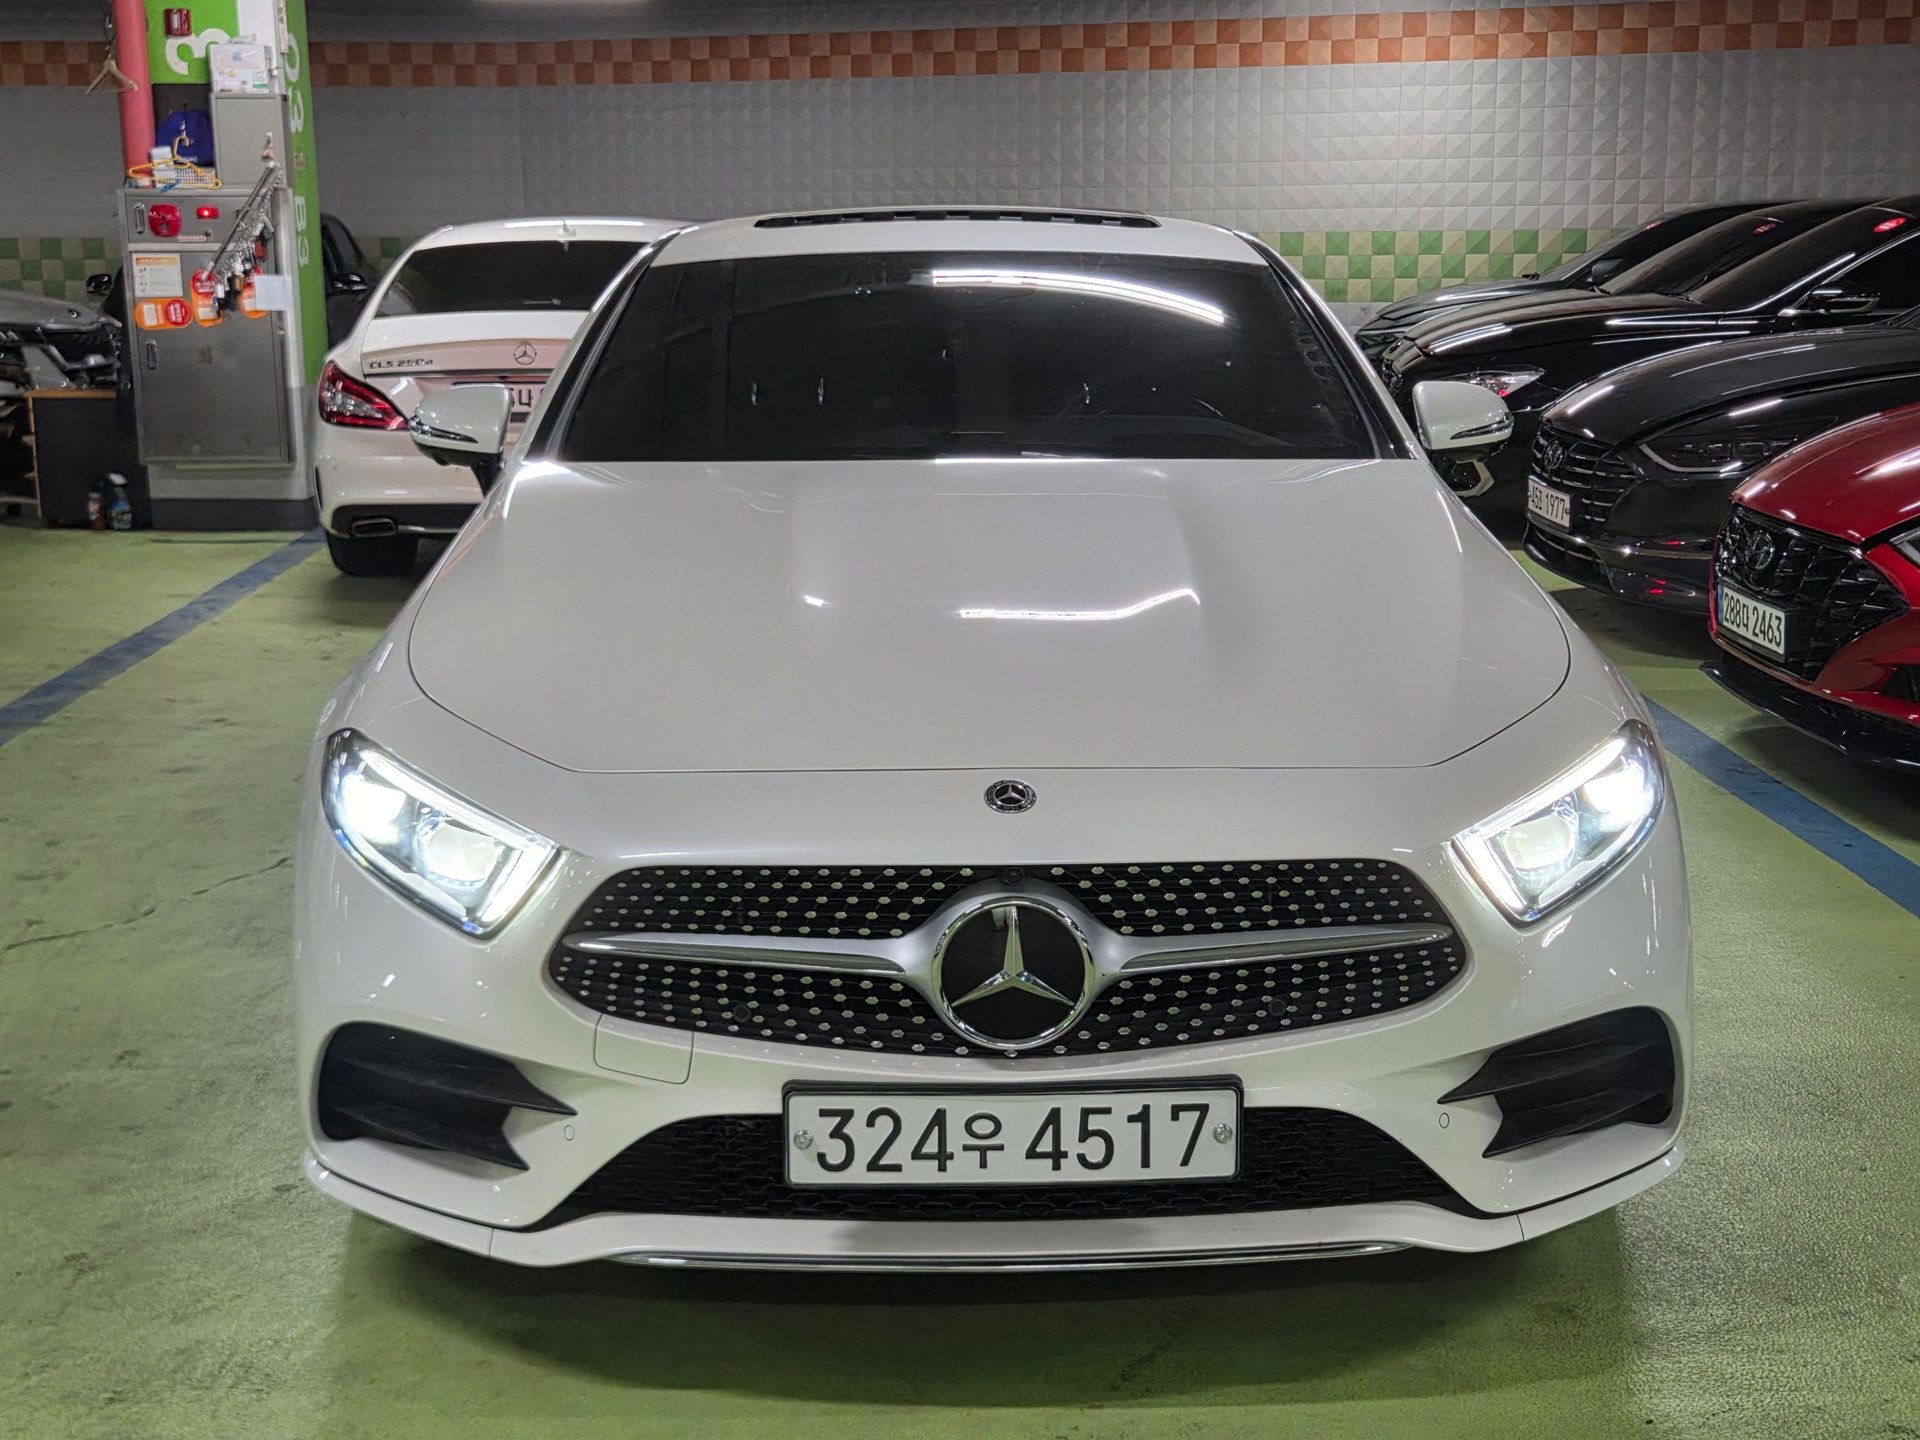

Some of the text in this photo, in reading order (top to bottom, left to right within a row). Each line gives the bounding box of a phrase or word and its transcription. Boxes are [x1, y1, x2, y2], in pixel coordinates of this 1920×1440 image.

[370, 360, 394, 369] CLS
[1545, 492, 1566, 521] 1977
[1724, 591, 1782, 648] 288다 2463
[816, 1103, 1210, 1173] 324우 4517
